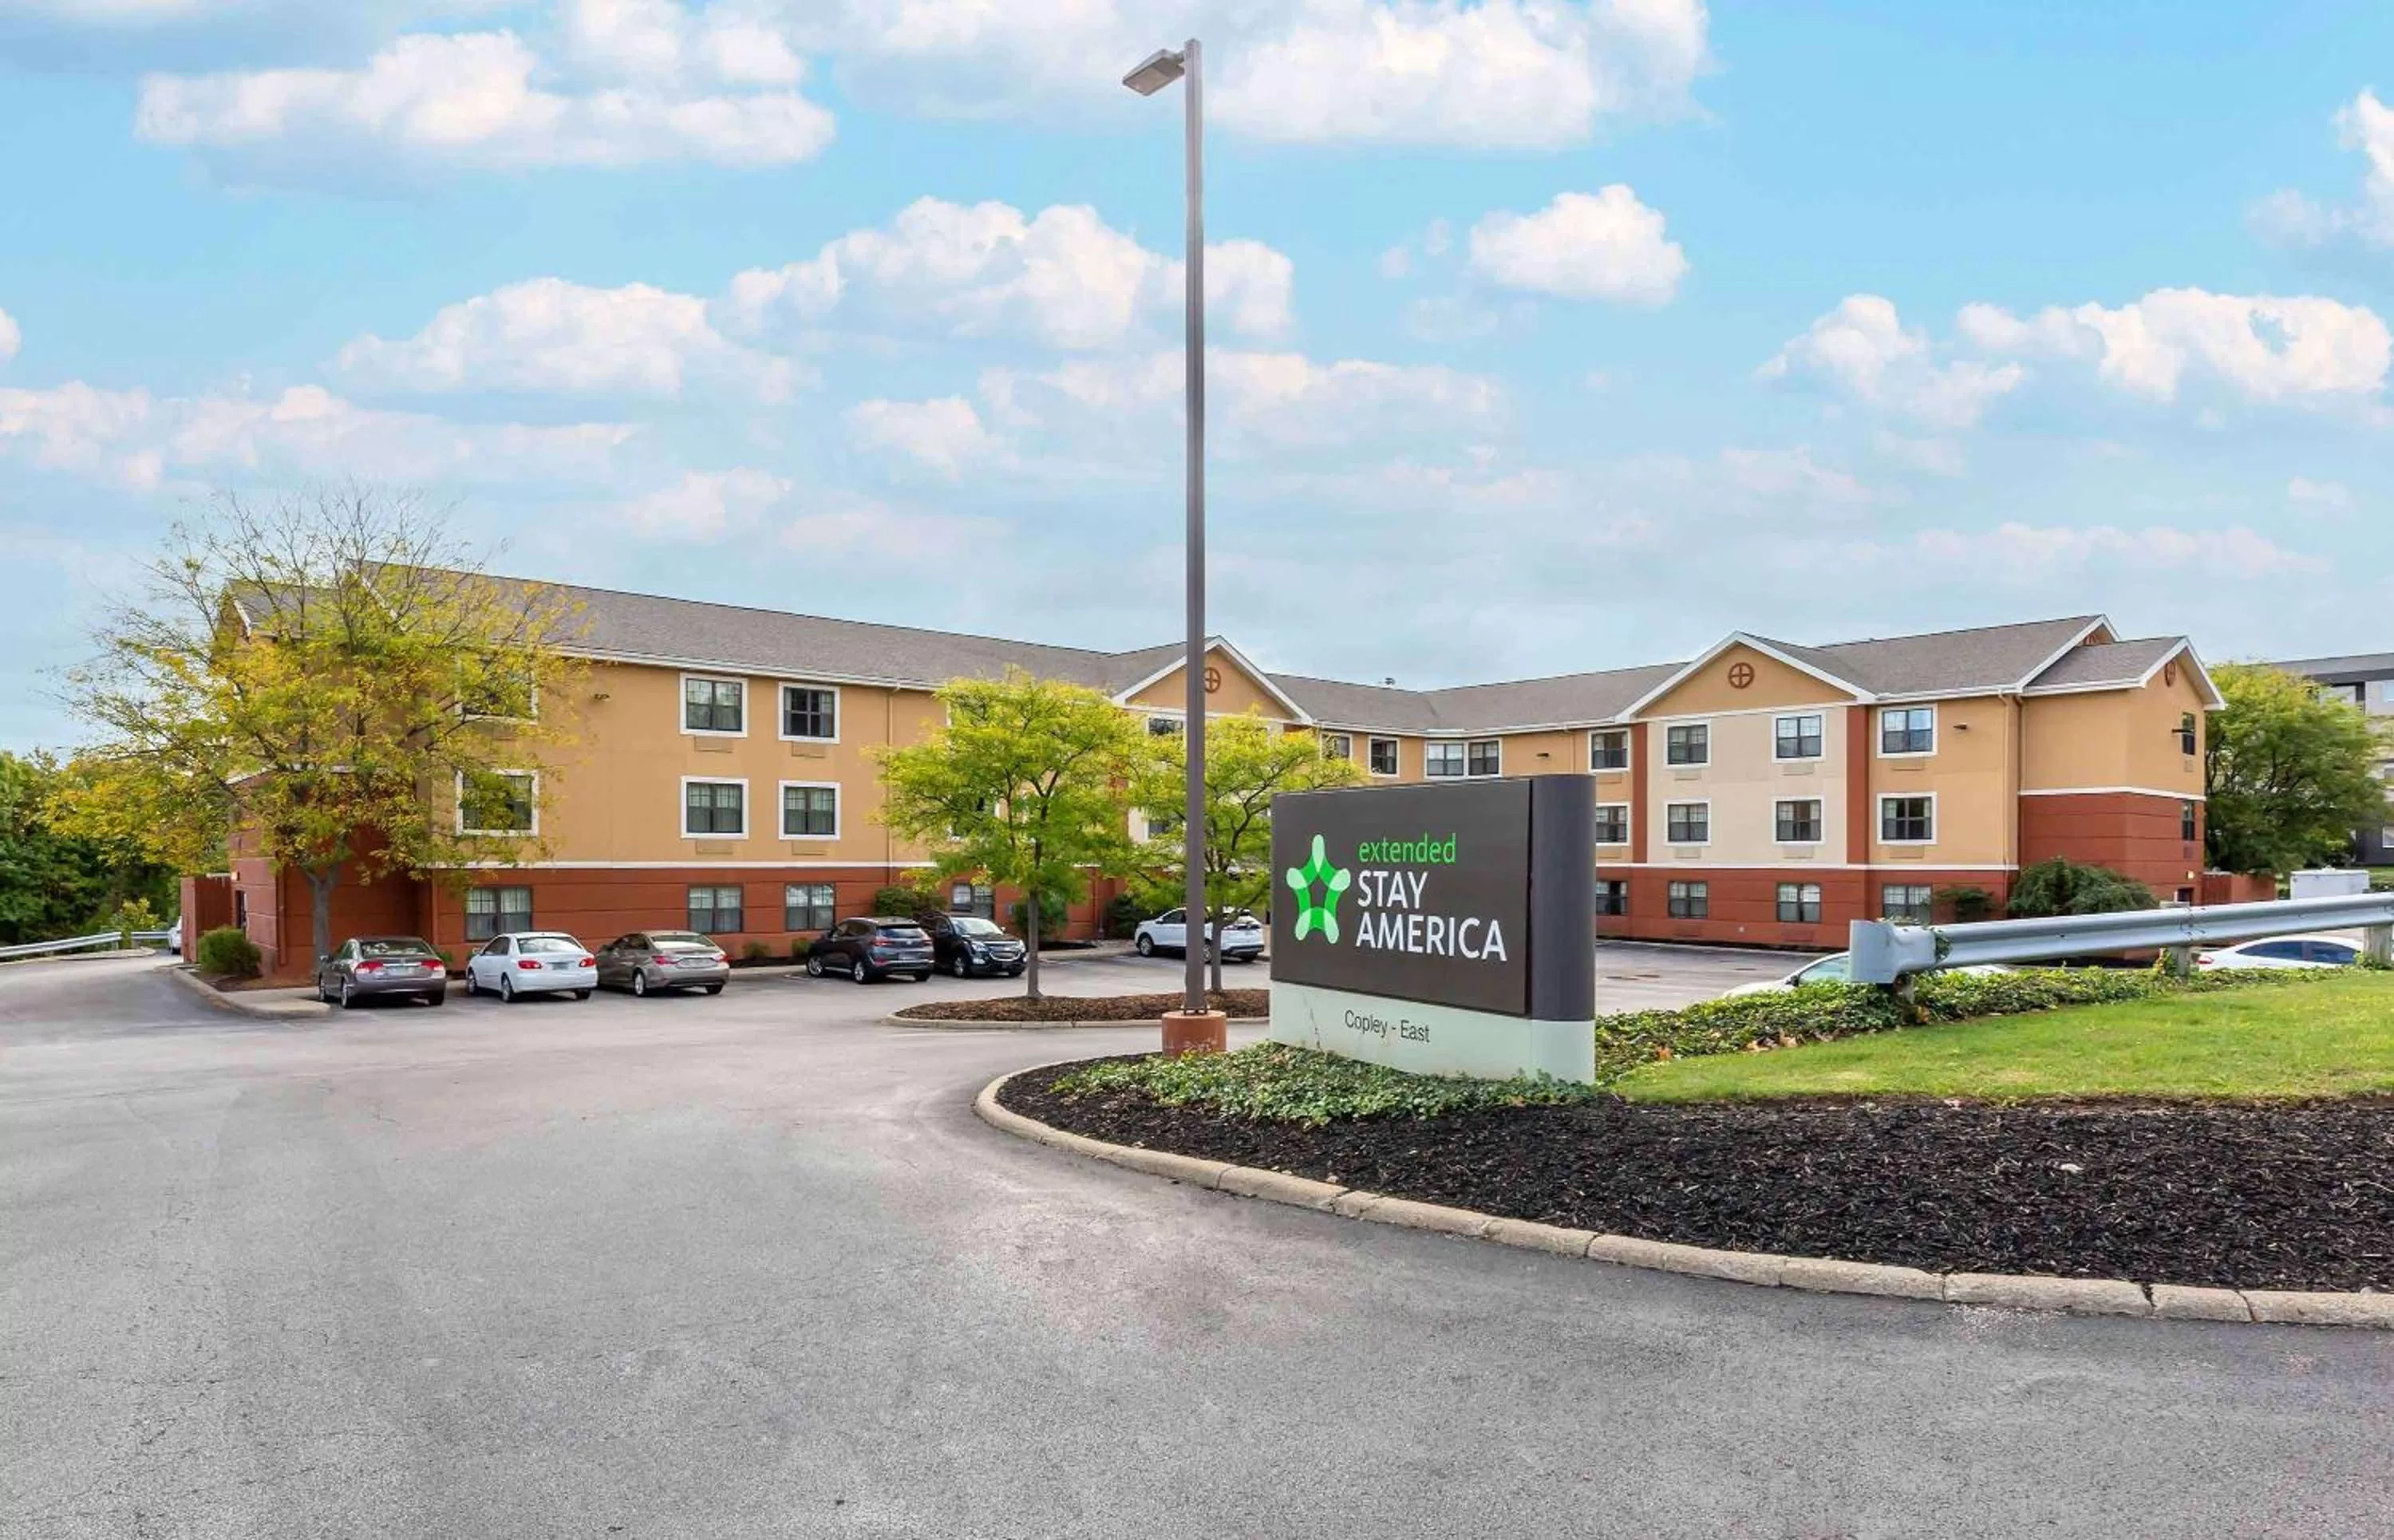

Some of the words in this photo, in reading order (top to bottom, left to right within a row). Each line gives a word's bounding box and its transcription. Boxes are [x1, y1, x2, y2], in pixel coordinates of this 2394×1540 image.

[1359, 832, 1456, 863] extended
[1357, 870, 1428, 909] STAY
[1355, 912, 1507, 962] AMERICA
[1344, 1009, 1388, 1038] Copley
[1400, 1020, 1431, 1043] East
